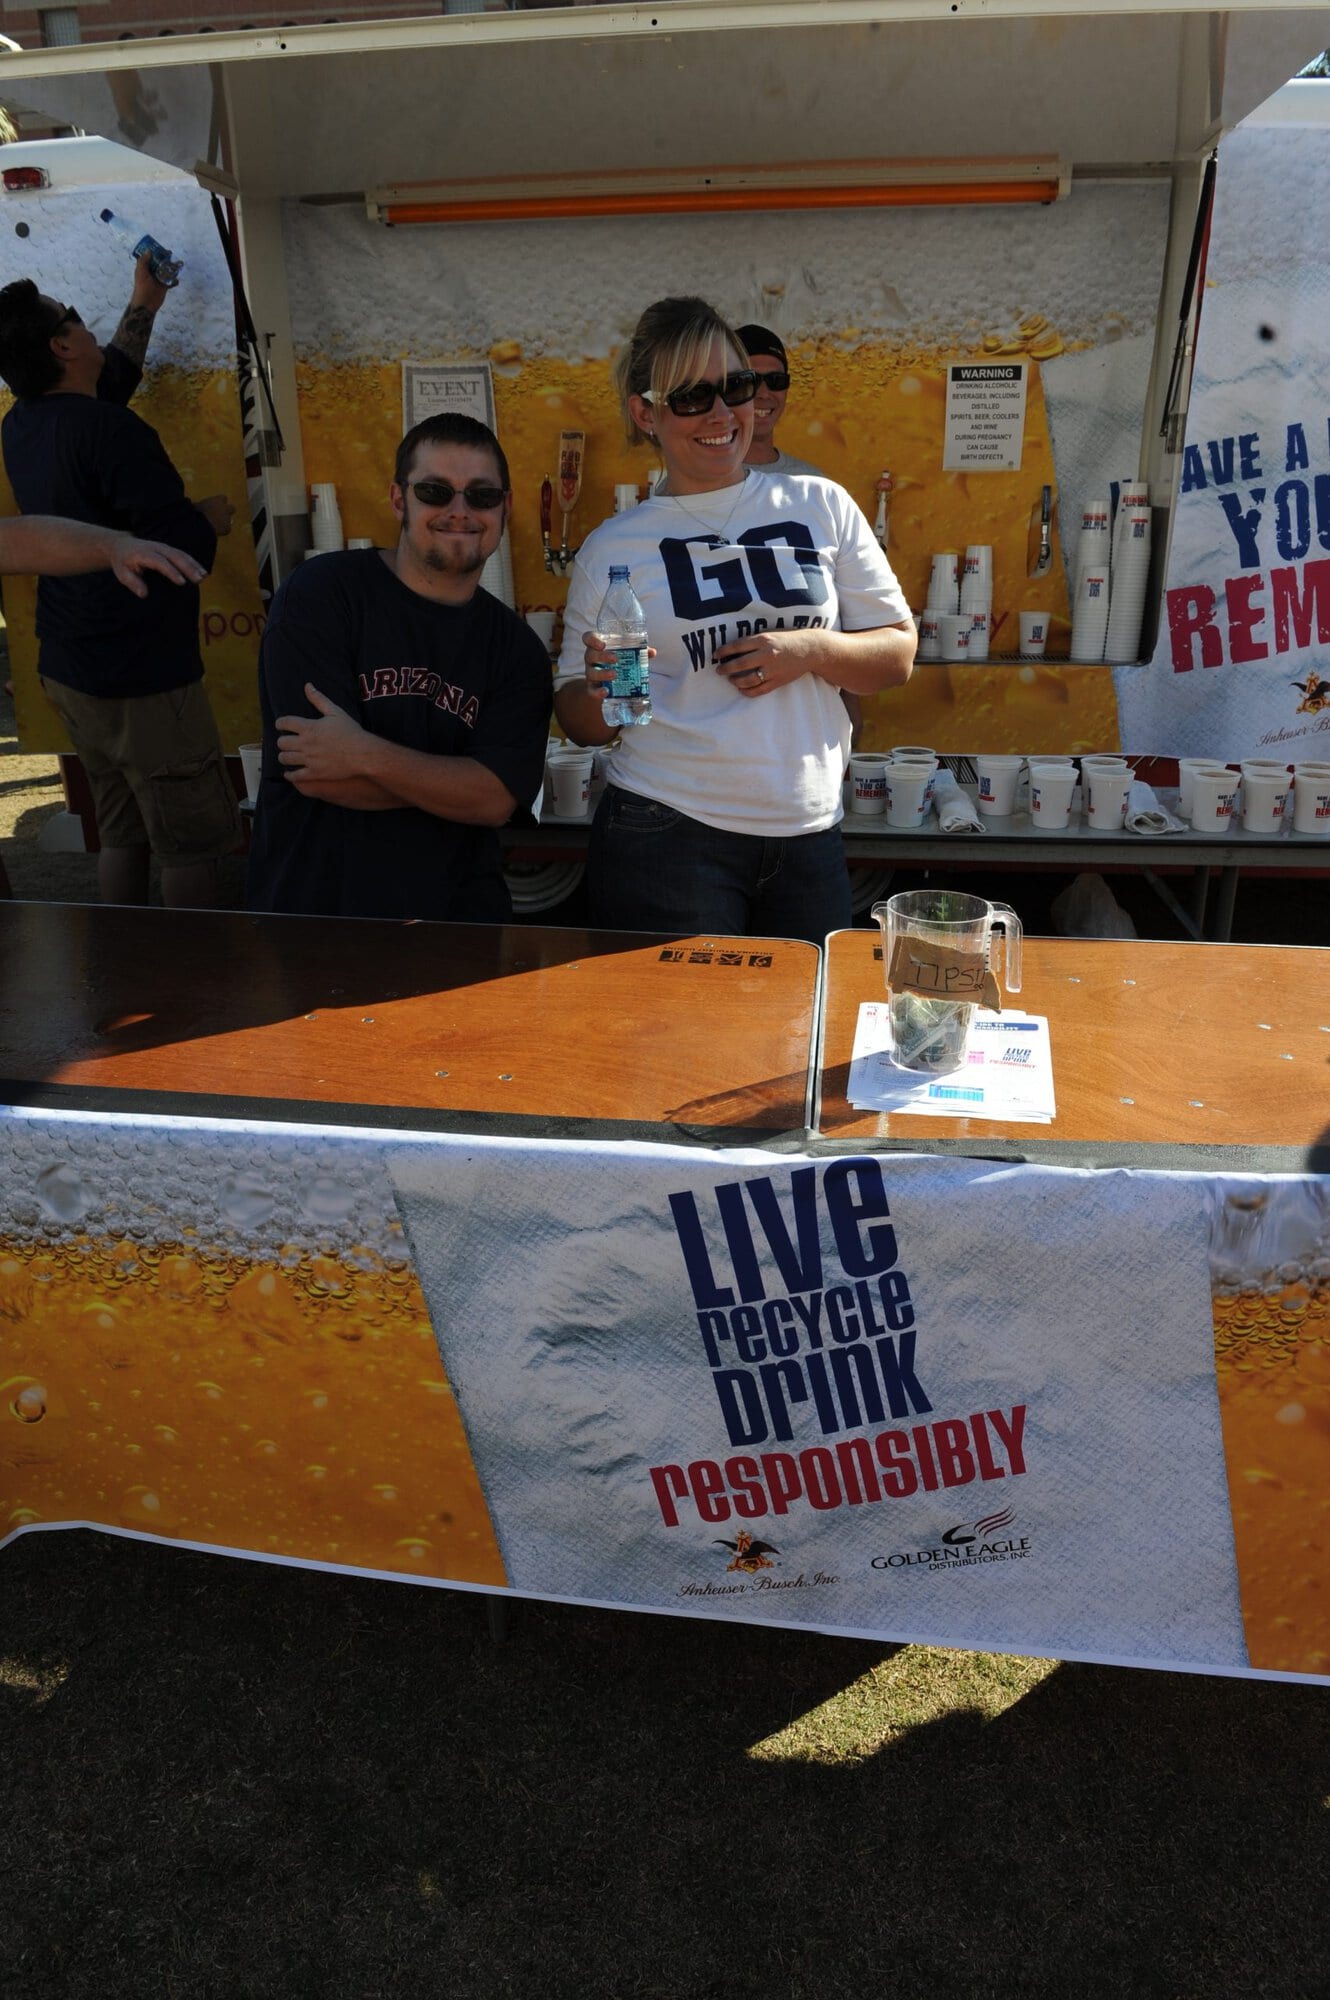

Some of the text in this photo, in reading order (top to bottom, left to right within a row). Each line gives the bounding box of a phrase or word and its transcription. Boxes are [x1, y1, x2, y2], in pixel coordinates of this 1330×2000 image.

[419, 381, 480, 396] EVENT
[961, 368, 1014, 379] WARNING
[1181, 422, 1309, 493] AVE A
[658, 520, 830, 621] GO
[1255, 716, 1330, 748] Anheuser-B
[871, 1537, 1032, 1570] GOLDEN EAGLE
[1011, 1550, 1034, 1560] INC.
